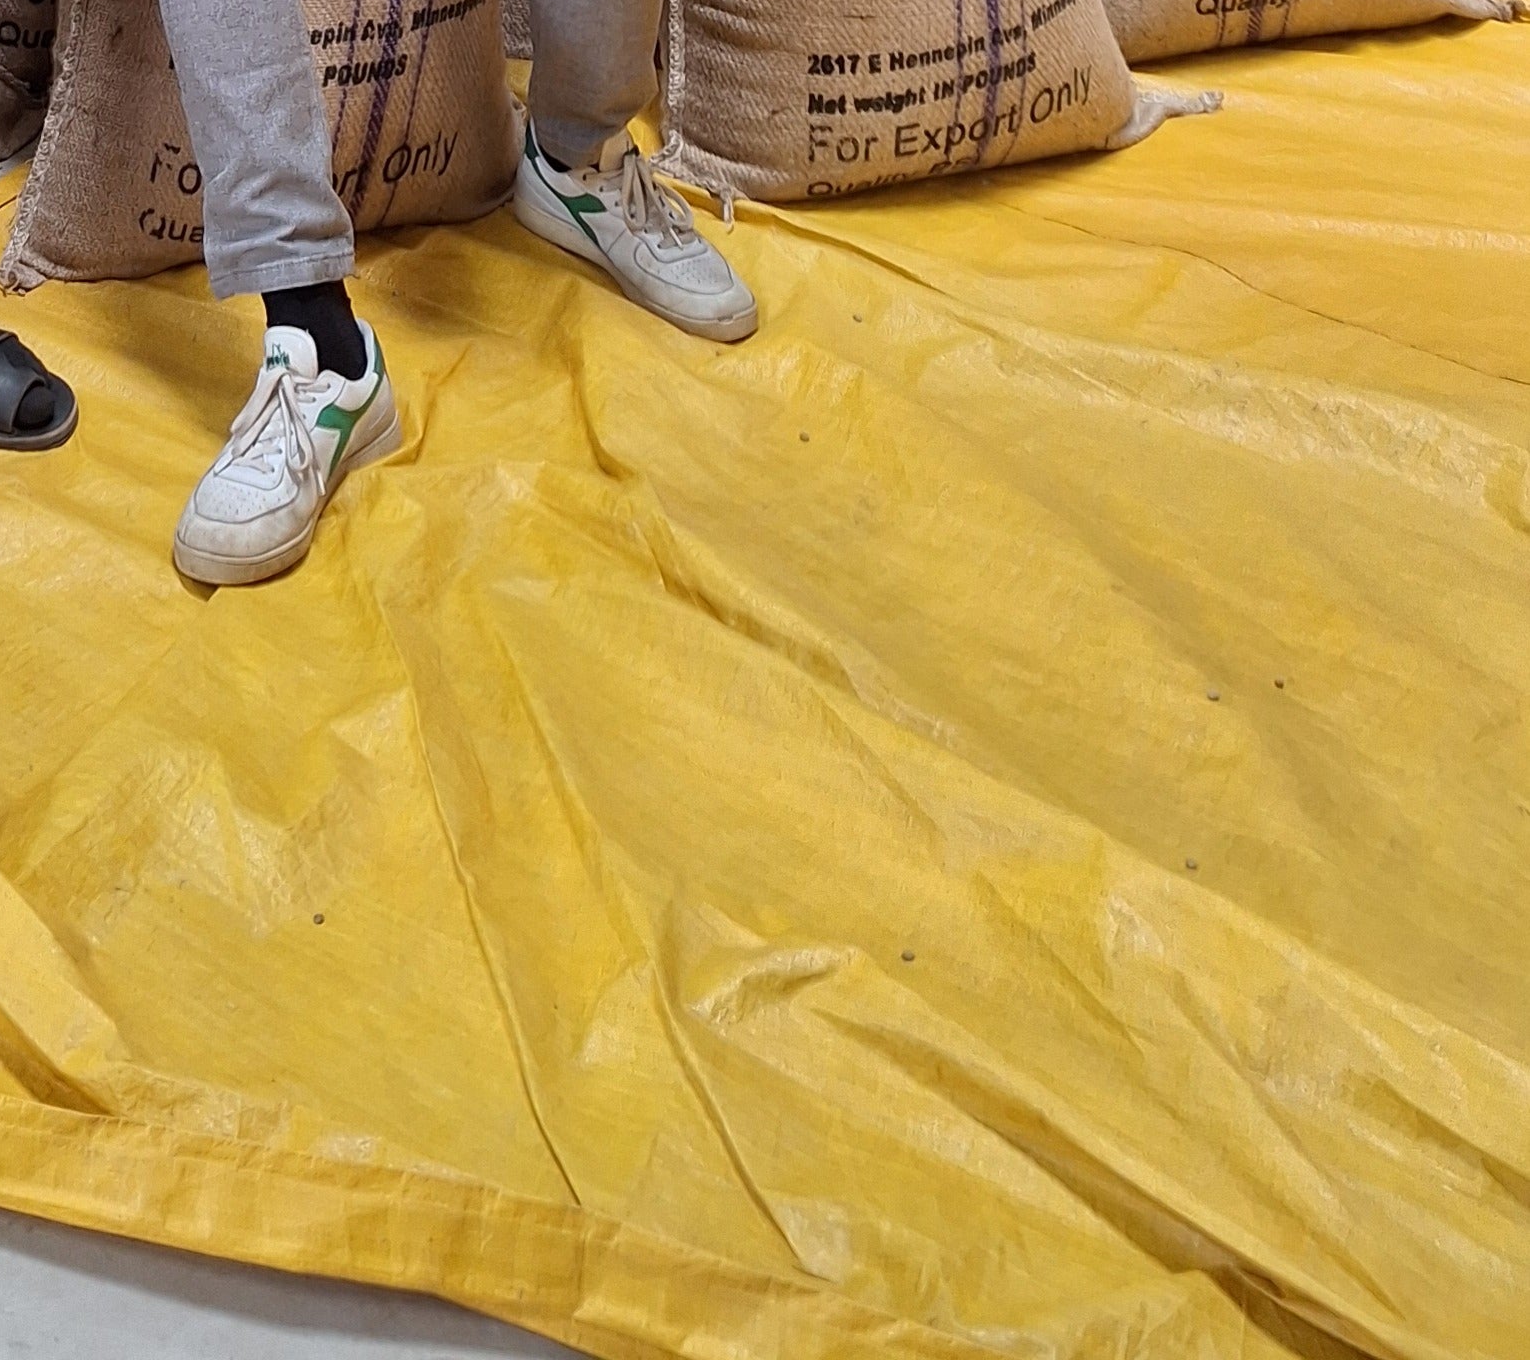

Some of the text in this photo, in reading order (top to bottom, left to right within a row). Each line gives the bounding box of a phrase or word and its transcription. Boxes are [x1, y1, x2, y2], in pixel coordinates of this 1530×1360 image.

[321, 52, 409, 89] POUNDS
[807, 51, 1038, 116] Net weight IN POUNDS
[867, 53, 882, 74] E
[808, 64, 1093, 164] For Export Only
[381, 129, 459, 184] Only
